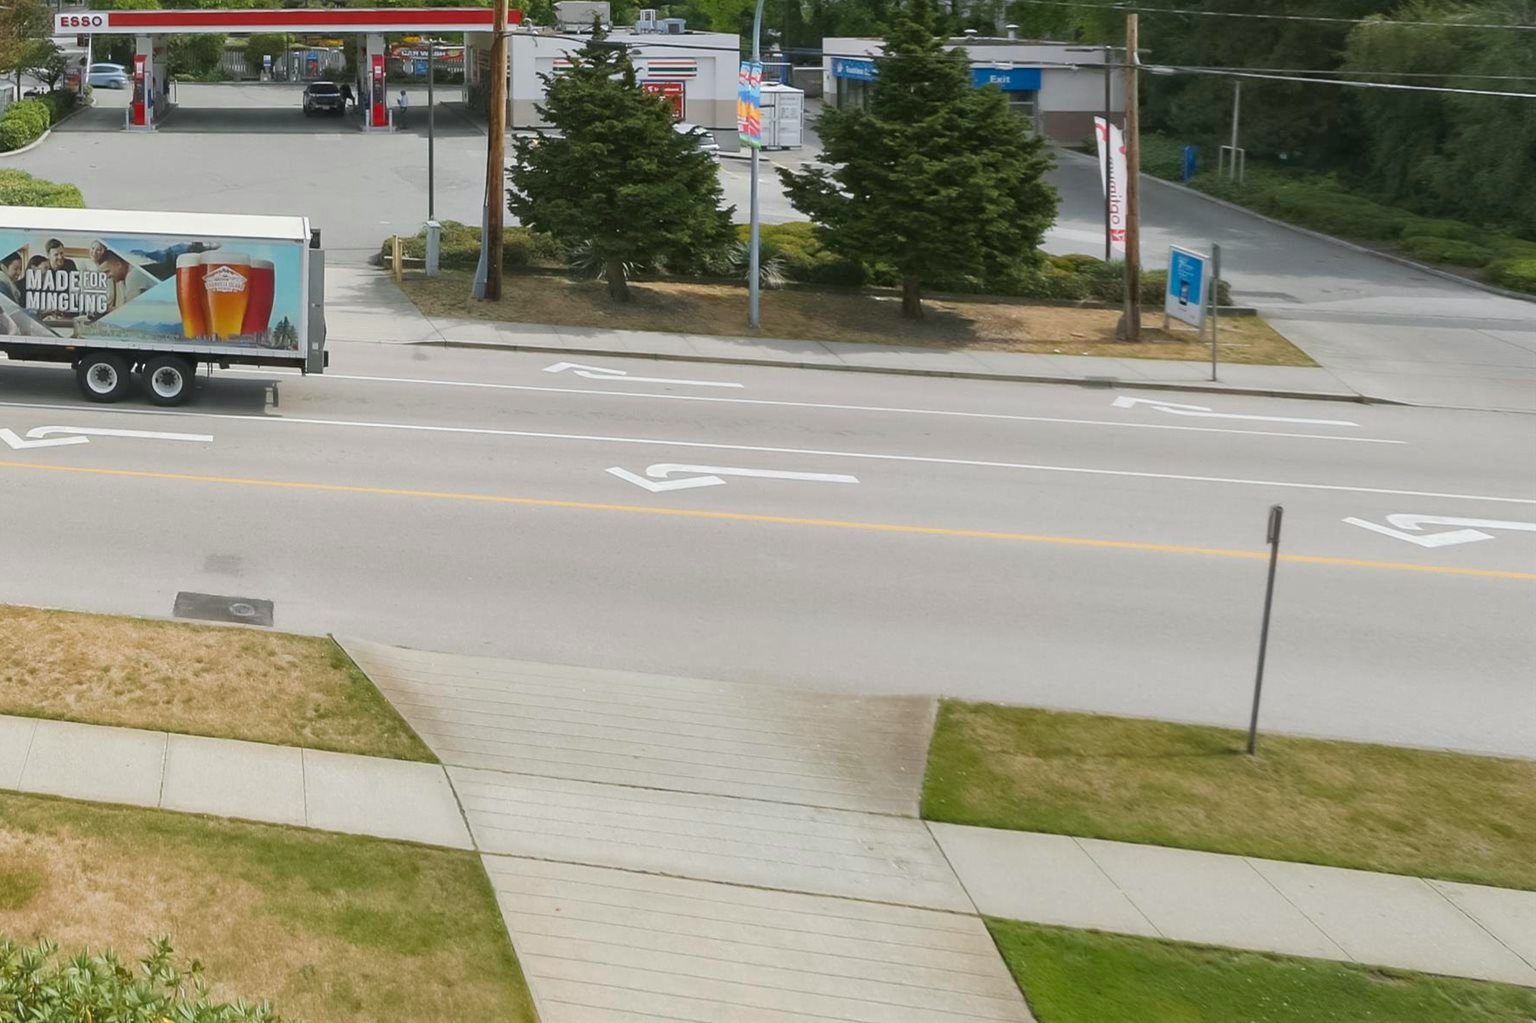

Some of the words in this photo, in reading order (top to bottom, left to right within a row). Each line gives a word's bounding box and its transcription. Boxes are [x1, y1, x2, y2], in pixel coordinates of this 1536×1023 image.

[60, 16, 103, 27] ESSO
[990, 74, 1010, 84] Exit
[25, 269, 80, 291] MADE
[83, 271, 107, 288] FOR
[25, 291, 108, 314] MINGLING
